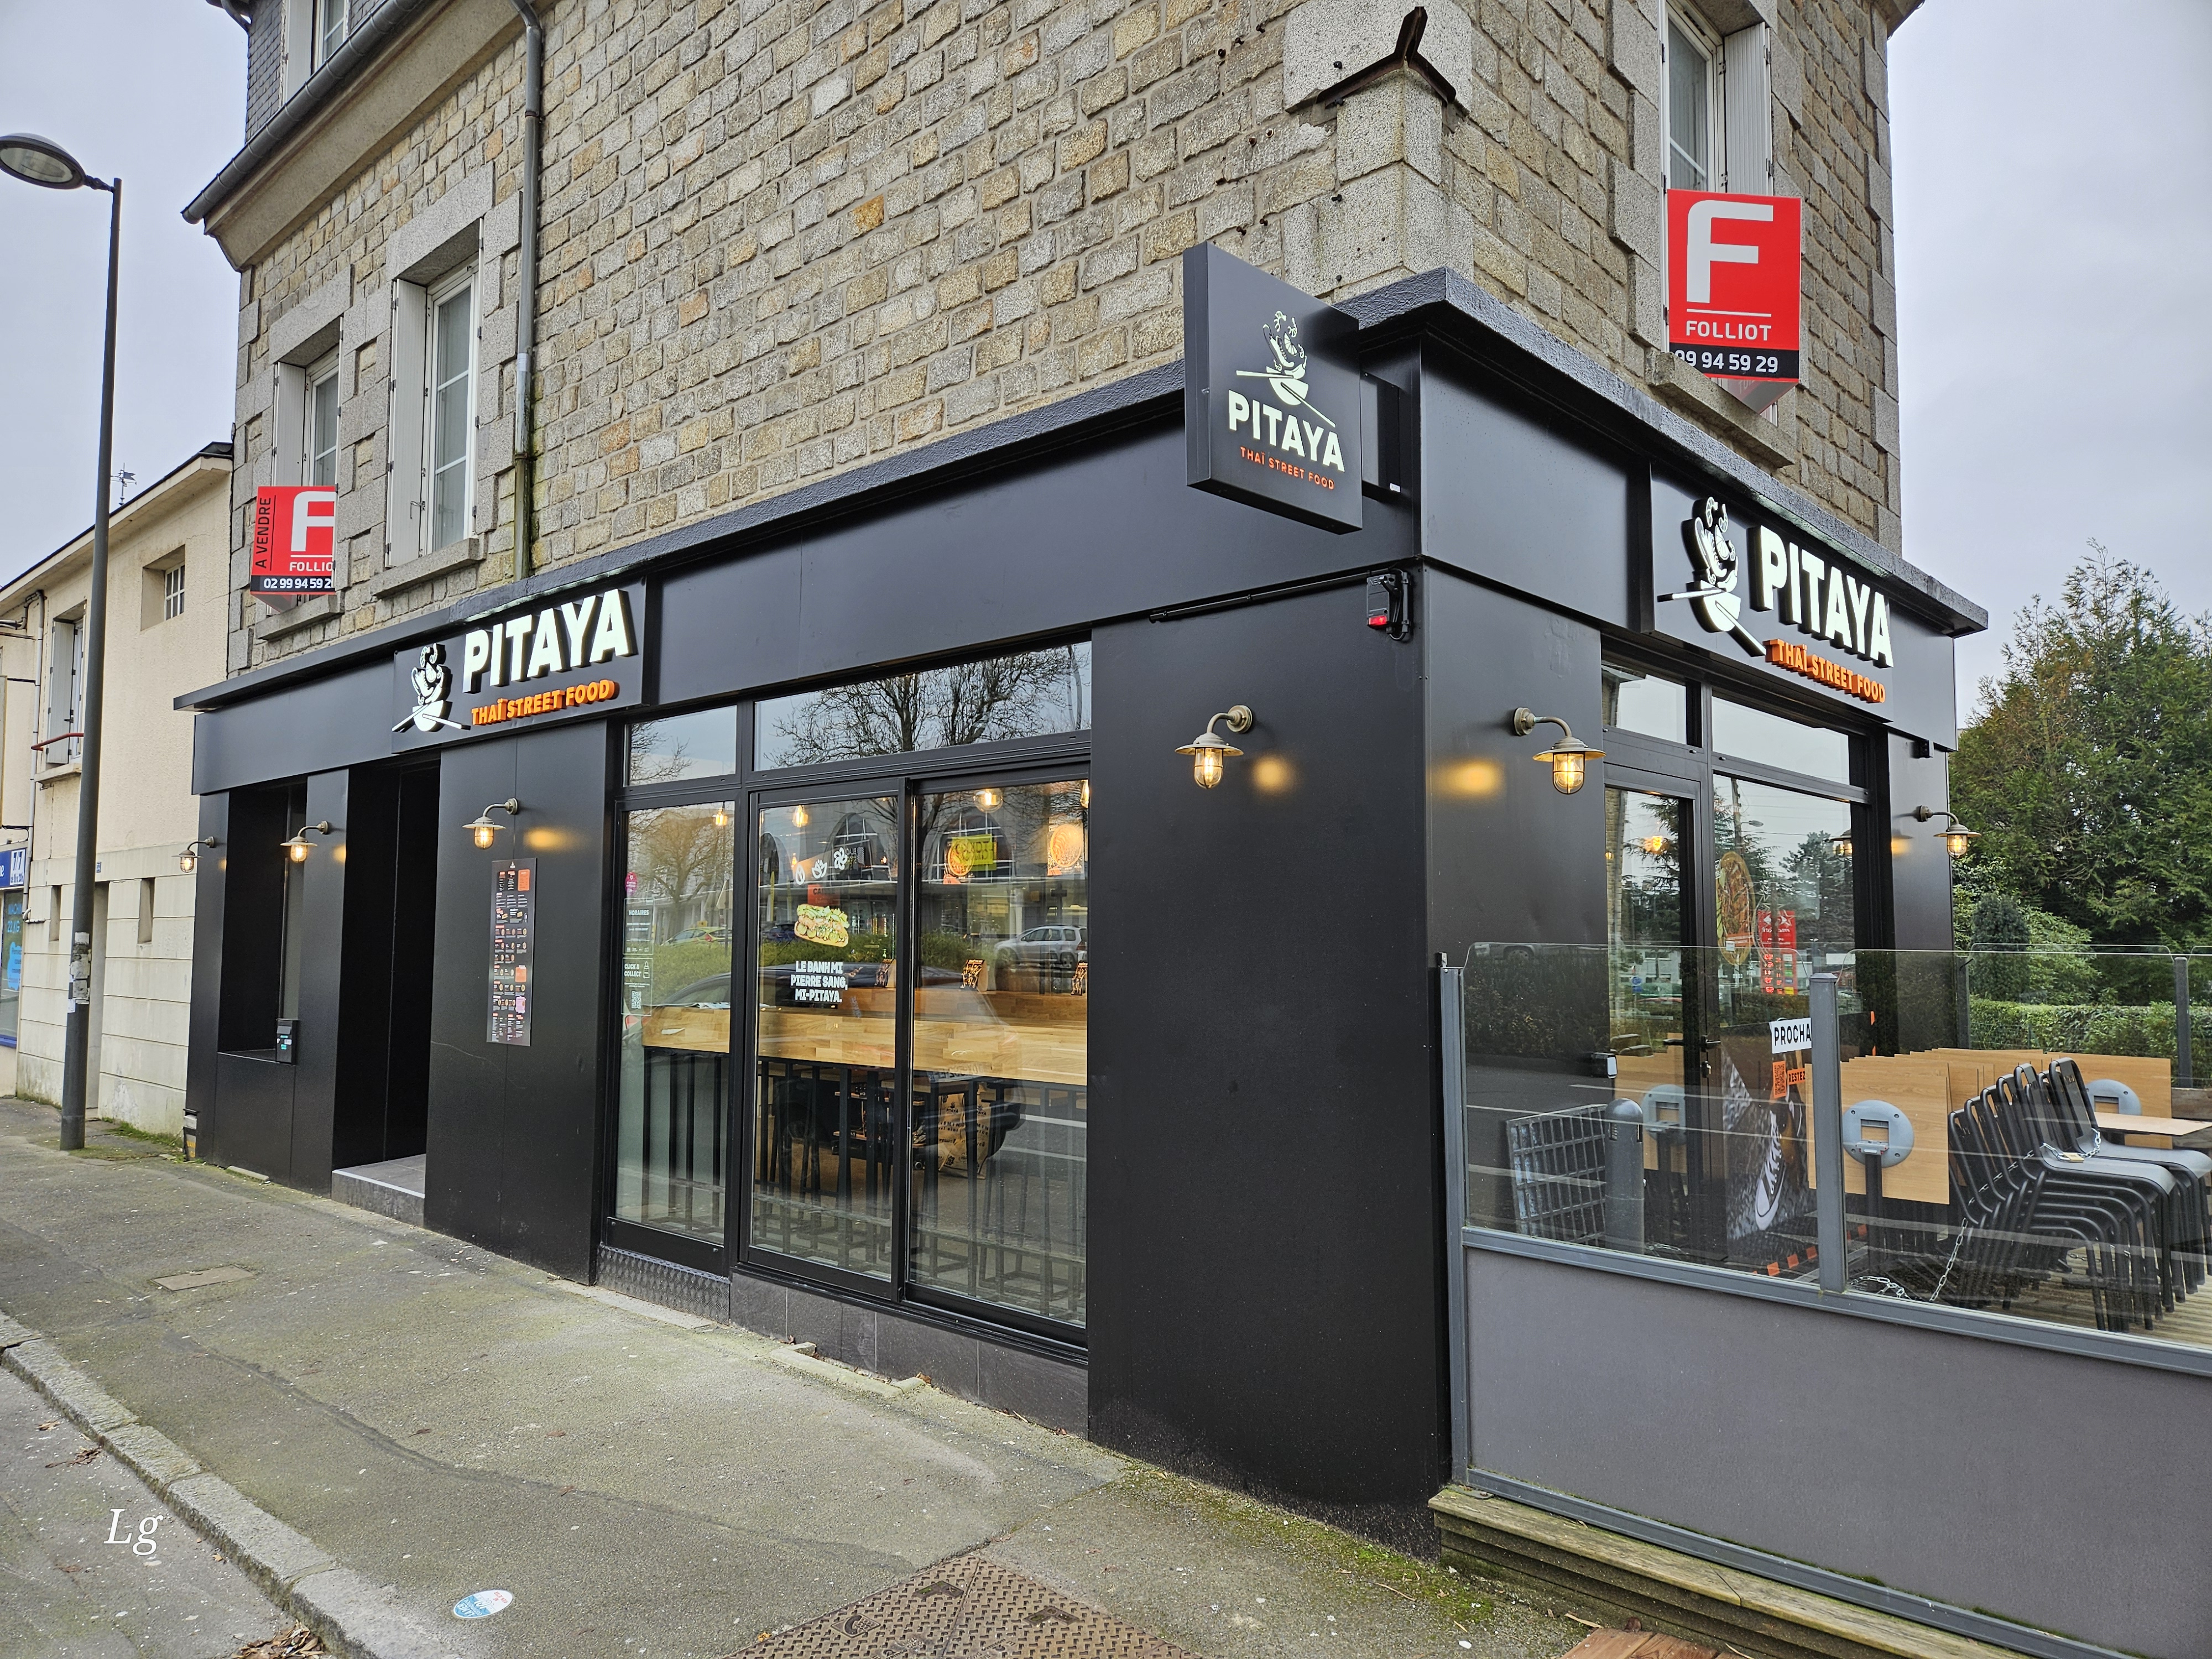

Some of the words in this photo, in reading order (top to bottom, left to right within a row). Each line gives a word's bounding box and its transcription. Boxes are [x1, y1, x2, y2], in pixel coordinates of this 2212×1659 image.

[1687, 200, 1773, 303] F
[1686, 321, 1772, 341] FOLLIOT
[1702, 352, 1724, 369] 94
[1729, 354, 1751, 371] 59
[1755, 356, 1778, 373] 29
[1229, 389, 1345, 472] PITAYA
[1240, 446, 1265, 465] THAÏ
[1269, 457, 1305, 479] STREET
[1308, 471, 1335, 490] FOOD
[255, 497, 271, 554] VENDRE
[255, 559, 267, 568] A
[263, 578, 278, 589] 02
[279, 578, 293, 589] 99
[294, 578, 309, 589] 94
[309, 578, 324, 589] 59
[1760, 525, 1894, 667] PITAYA
[462, 588, 633, 693] PITAYA
[1771, 639, 1808, 671] THAÏ
[1811, 653, 1854, 691] STREET
[1857, 674, 1886, 703] FOOD
[471, 698, 505, 726] THAÏ
[507, 689, 561, 719] STREET
[565, 679, 614, 706] FOOD
[795, 961, 807, 973] LE
[807, 961, 831, 974] BANH
[831, 962, 843, 974] MI
[790, 974, 822, 988] PIERRE
[822, 975, 848, 990] SANG,
[795, 988, 843, 1003] MI-PITAYA.
[1774, 1023, 1812, 1046] PROCHA
[1788, 1071, 1806, 1082] RESTEZ
